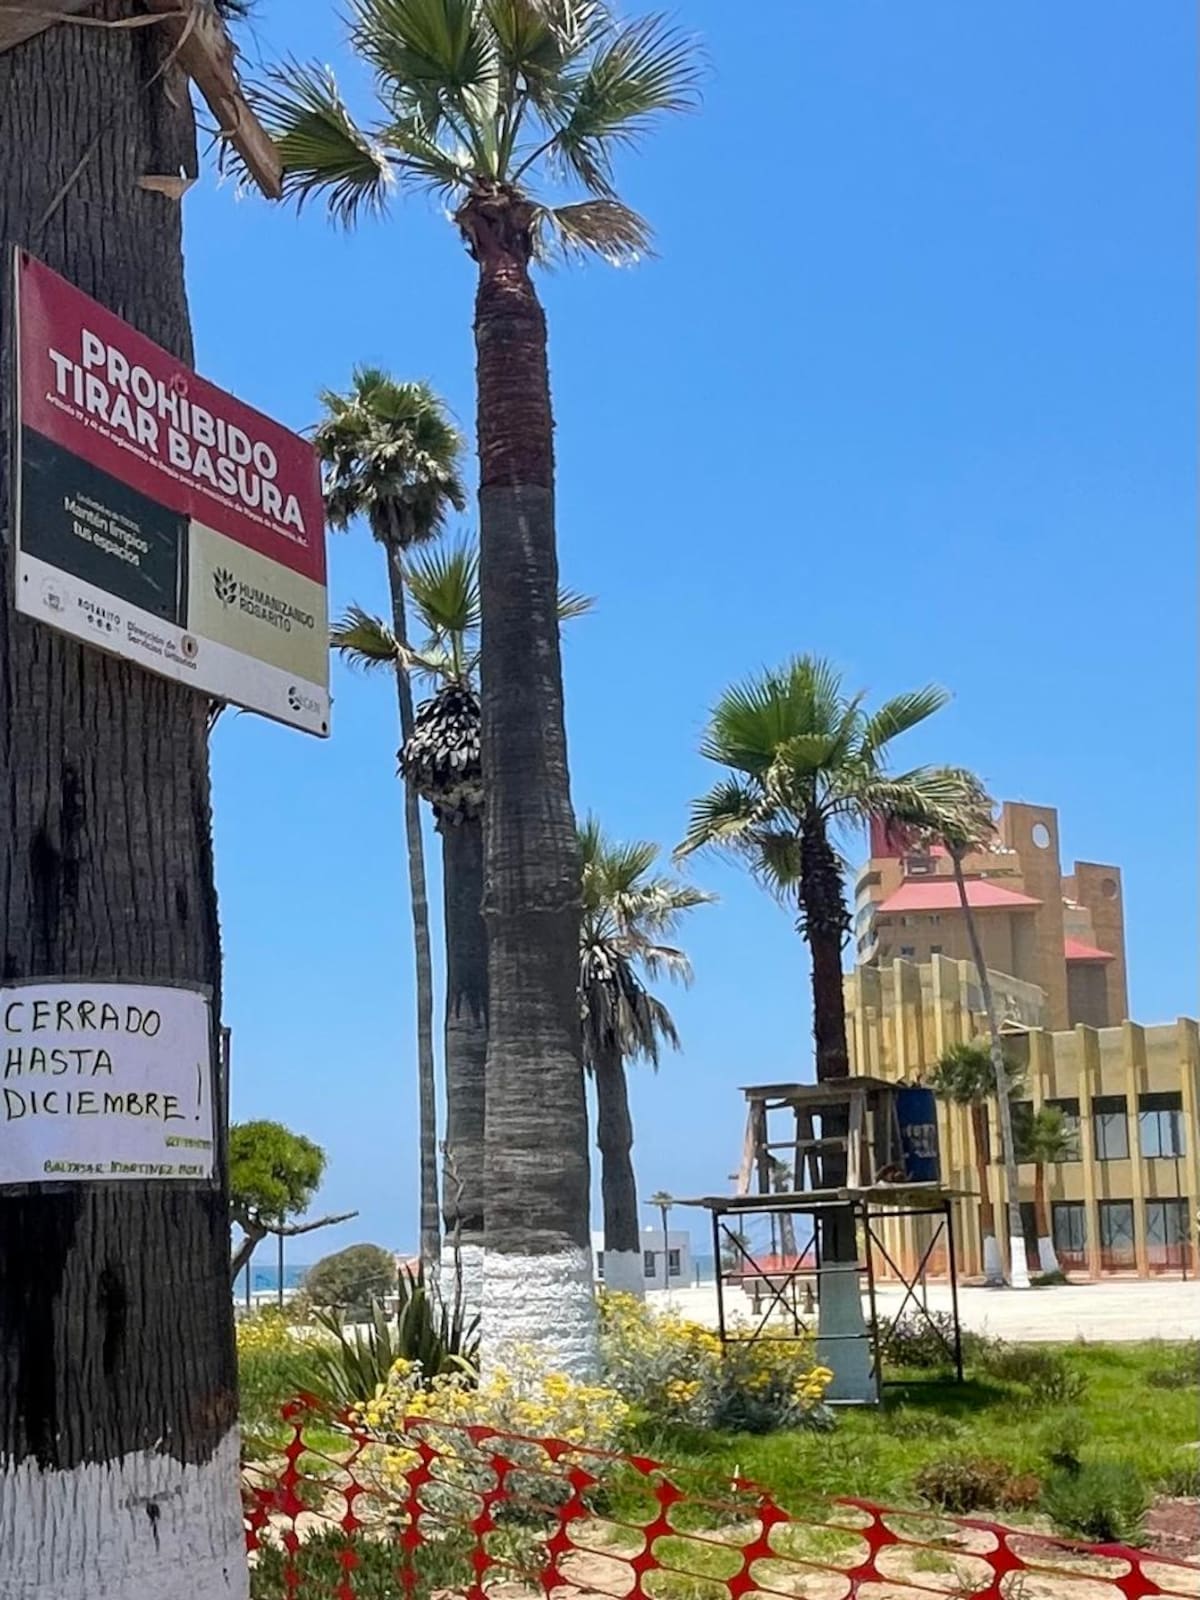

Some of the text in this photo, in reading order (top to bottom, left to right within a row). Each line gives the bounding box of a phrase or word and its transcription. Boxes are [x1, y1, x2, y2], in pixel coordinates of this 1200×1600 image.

[81, 328, 277, 479] PROHIBIDO
[49, 347, 306, 534] TIRAR BASURA
[73, 520, 140, 566] tus espacios
[109, 520, 148, 554] limpios
[5, 999, 161, 1037] CERRADO
[4, 1047, 113, 1080] HASTA
